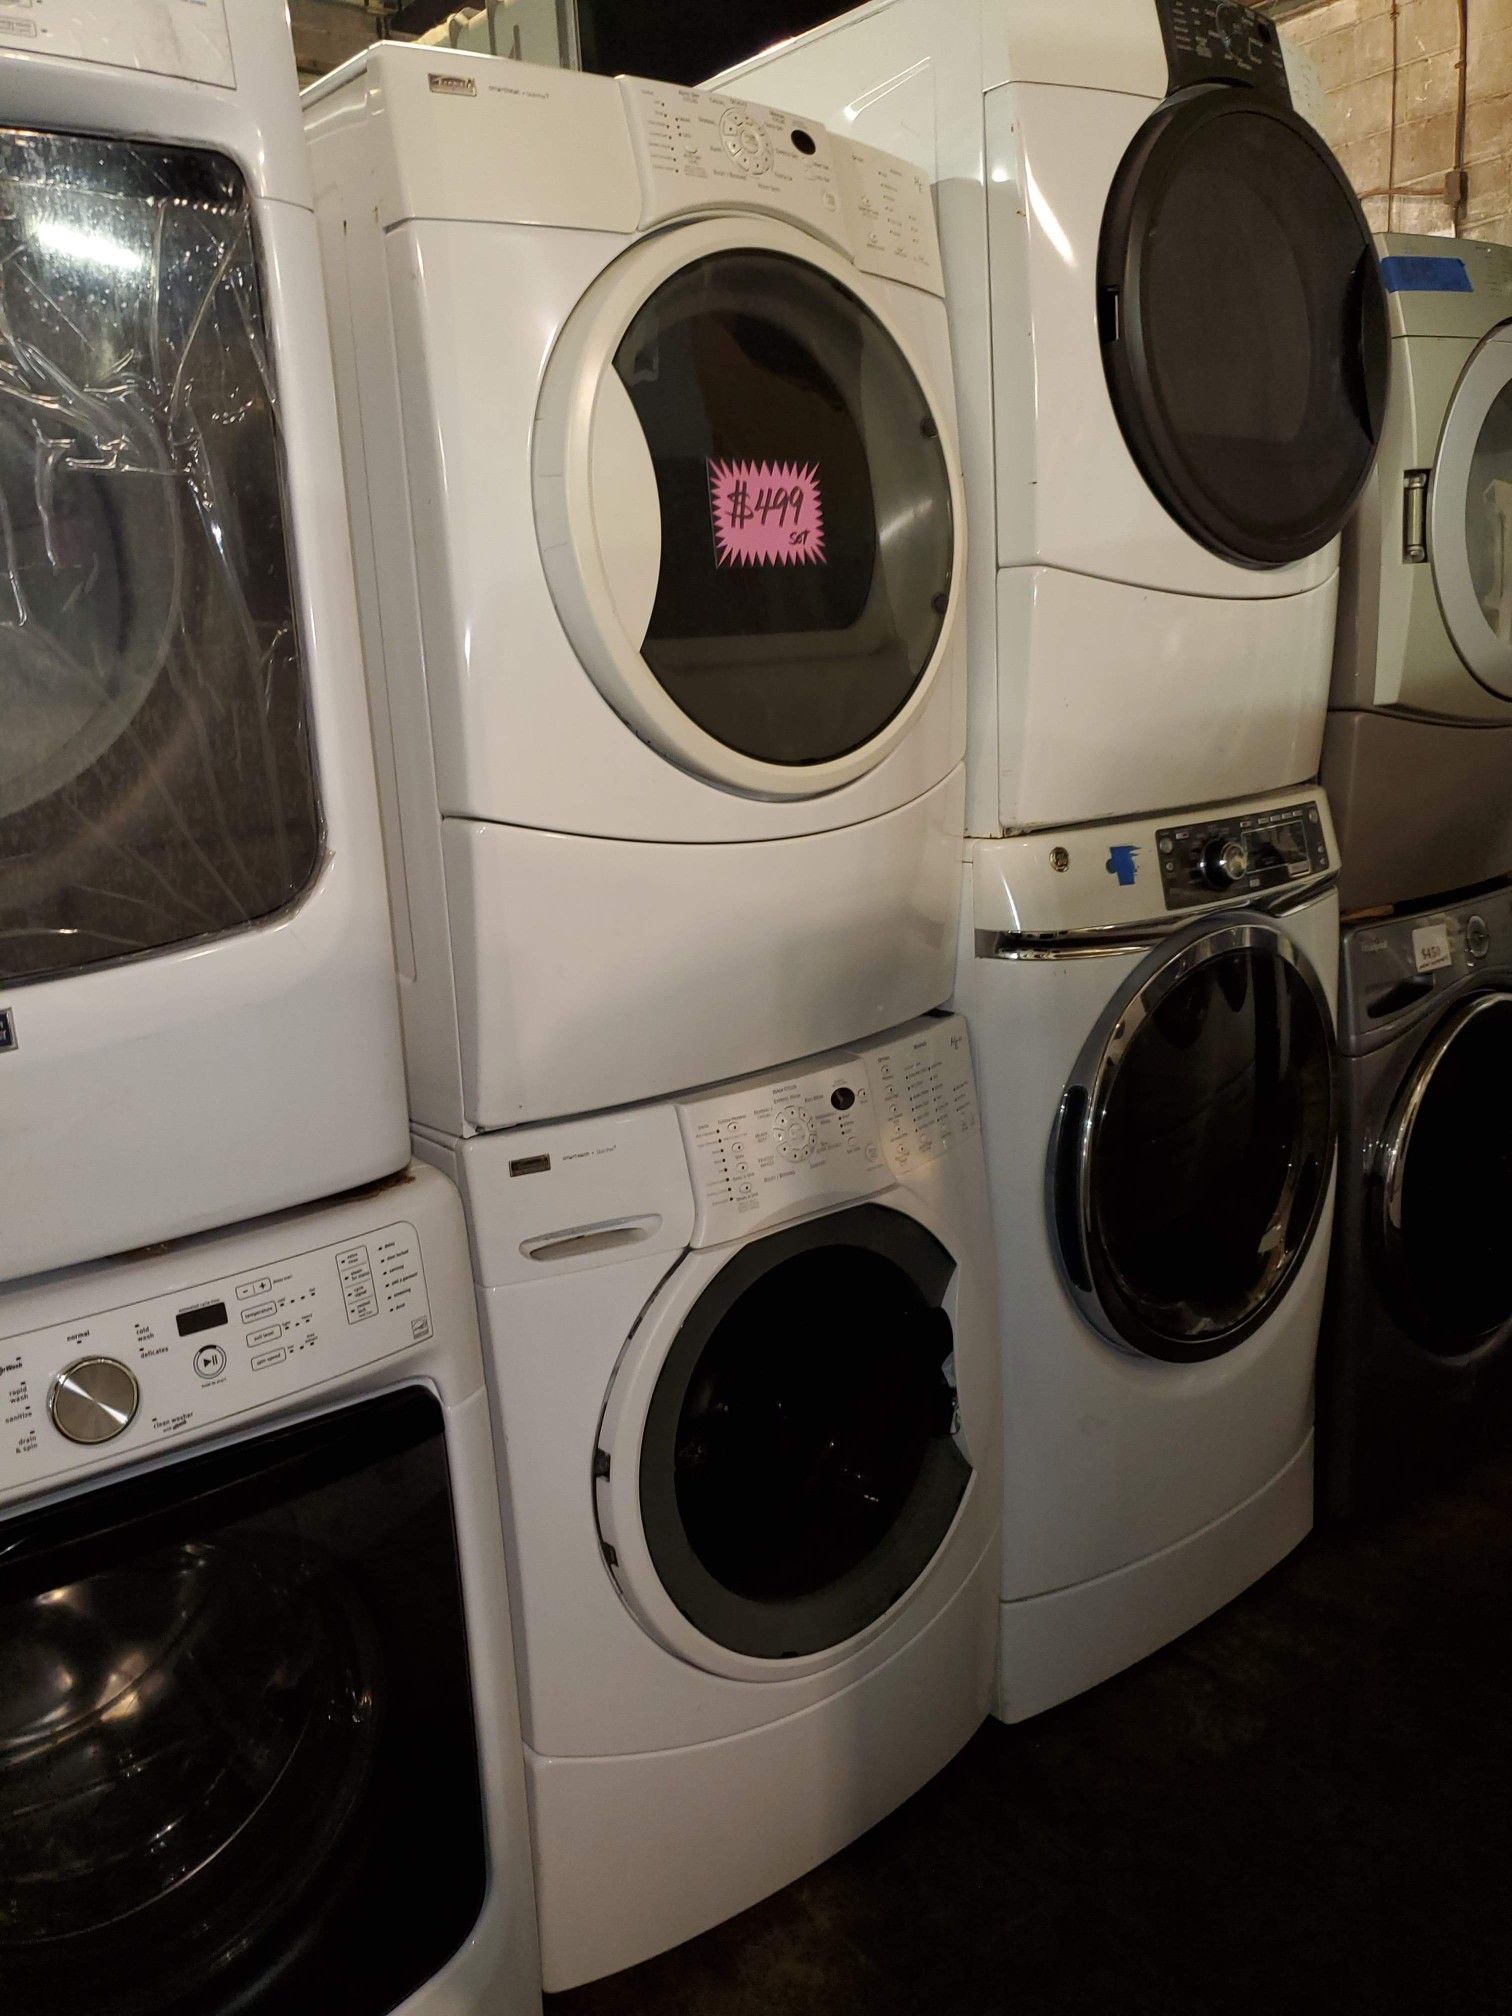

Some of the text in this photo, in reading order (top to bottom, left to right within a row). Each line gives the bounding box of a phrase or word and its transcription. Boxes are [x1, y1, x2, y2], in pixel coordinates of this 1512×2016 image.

[725, 479, 804, 529] $499
[66, 1330, 90, 1342] normal
[138, 1333, 154, 1342] wash
[140, 1346, 169, 1359] delicates
[9, 1386, 27, 1397] rapid
[10, 1394, 28, 1404] wash
[5, 1411, 32, 1423] sanitize
[18, 1436, 36, 1446] drain
[23, 1442, 38, 1453] spin
